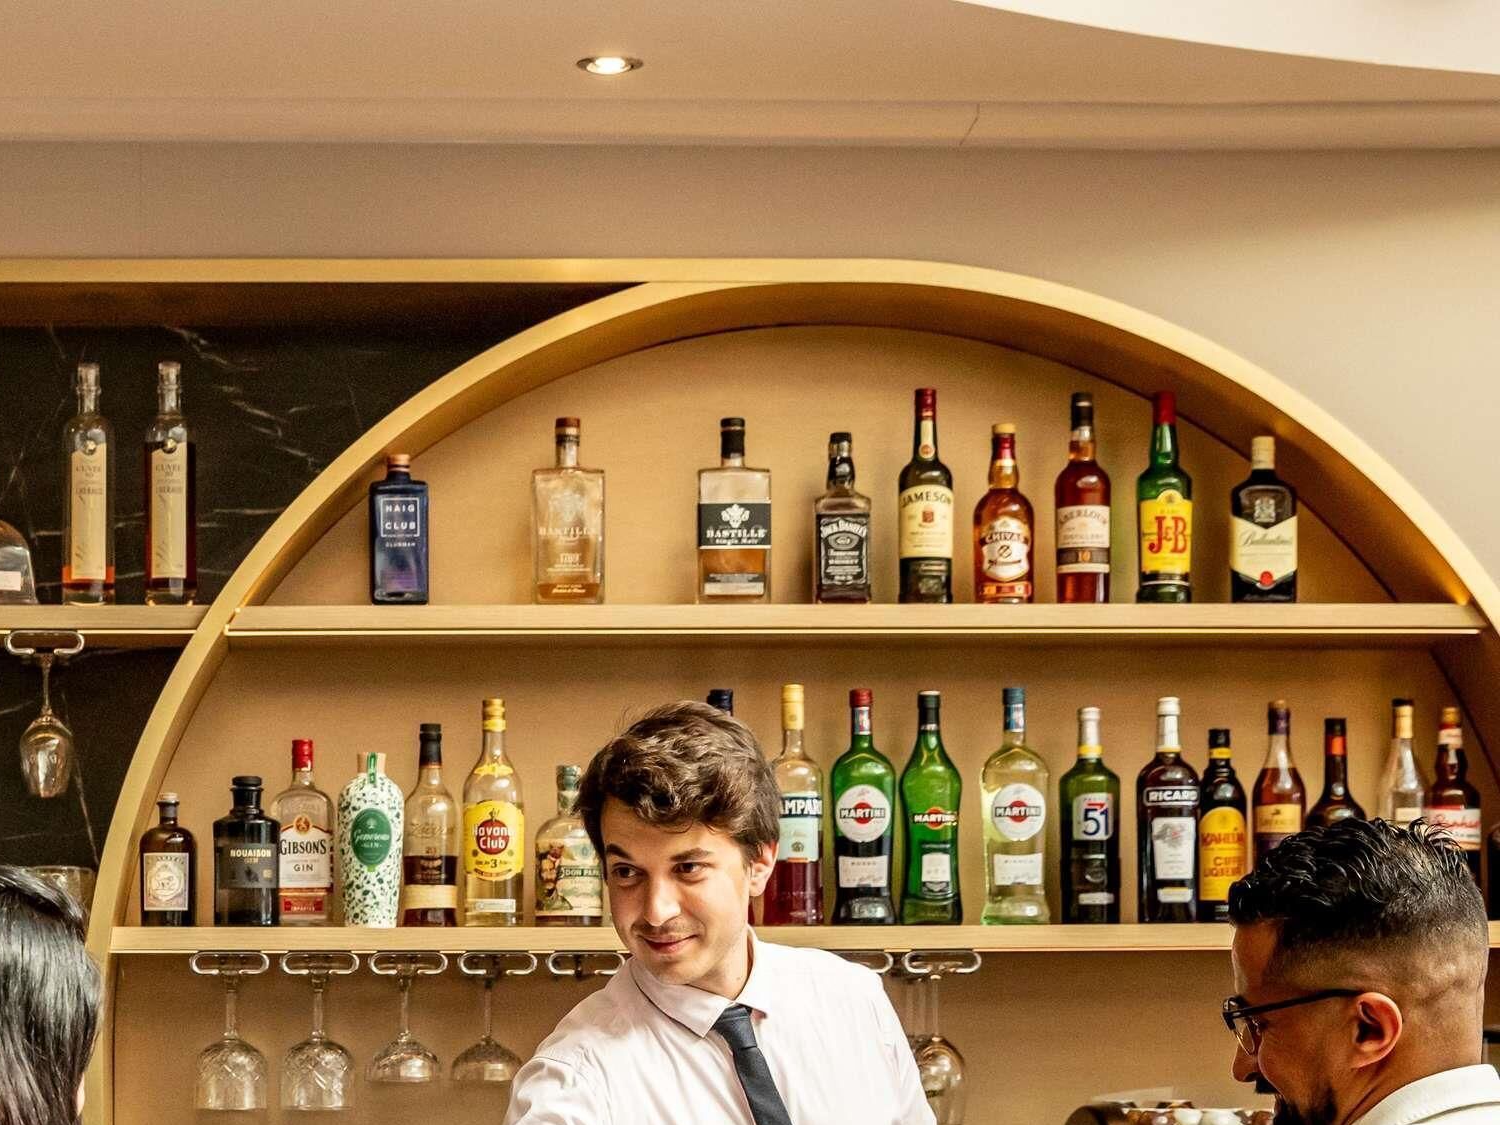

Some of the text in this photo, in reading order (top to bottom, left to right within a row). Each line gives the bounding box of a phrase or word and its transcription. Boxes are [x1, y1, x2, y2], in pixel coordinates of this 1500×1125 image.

[901, 491, 952, 508] JAMESON
[385, 504, 415, 512] HAIG
[385, 521, 416, 530] CLUB
[706, 528, 767, 538] BASTILLE
[1148, 790, 1198, 802] RICARD
[840, 808, 886, 819] MARTINI
[995, 806, 1041, 817] MARTINI
[913, 813, 957, 823] MARTINI
[1083, 807, 1109, 836] 51
[280, 839, 327, 855] GIBSON'S
[480, 836, 507, 849] Club
[230, 849, 272, 858] NOUAISON
[490, 858, 498, 869] 3
